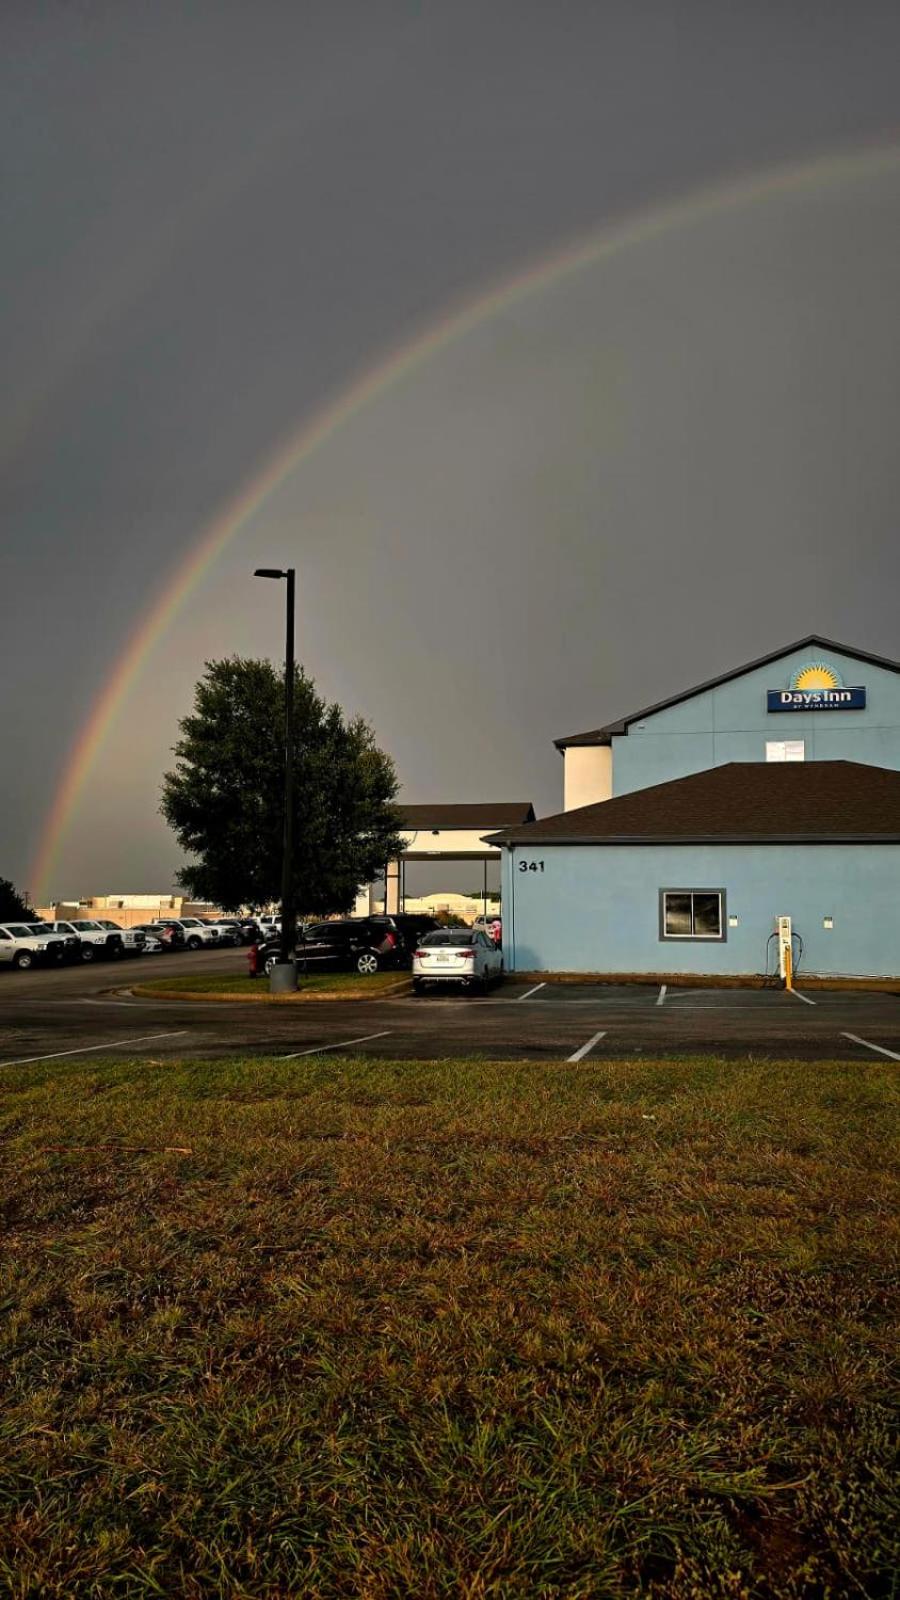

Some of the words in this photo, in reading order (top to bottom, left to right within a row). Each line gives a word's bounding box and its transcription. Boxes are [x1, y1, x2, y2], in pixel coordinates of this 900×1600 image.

[781, 692, 821, 703] Days
[823, 690, 851, 701] Inn
[519, 860, 545, 873] 341
